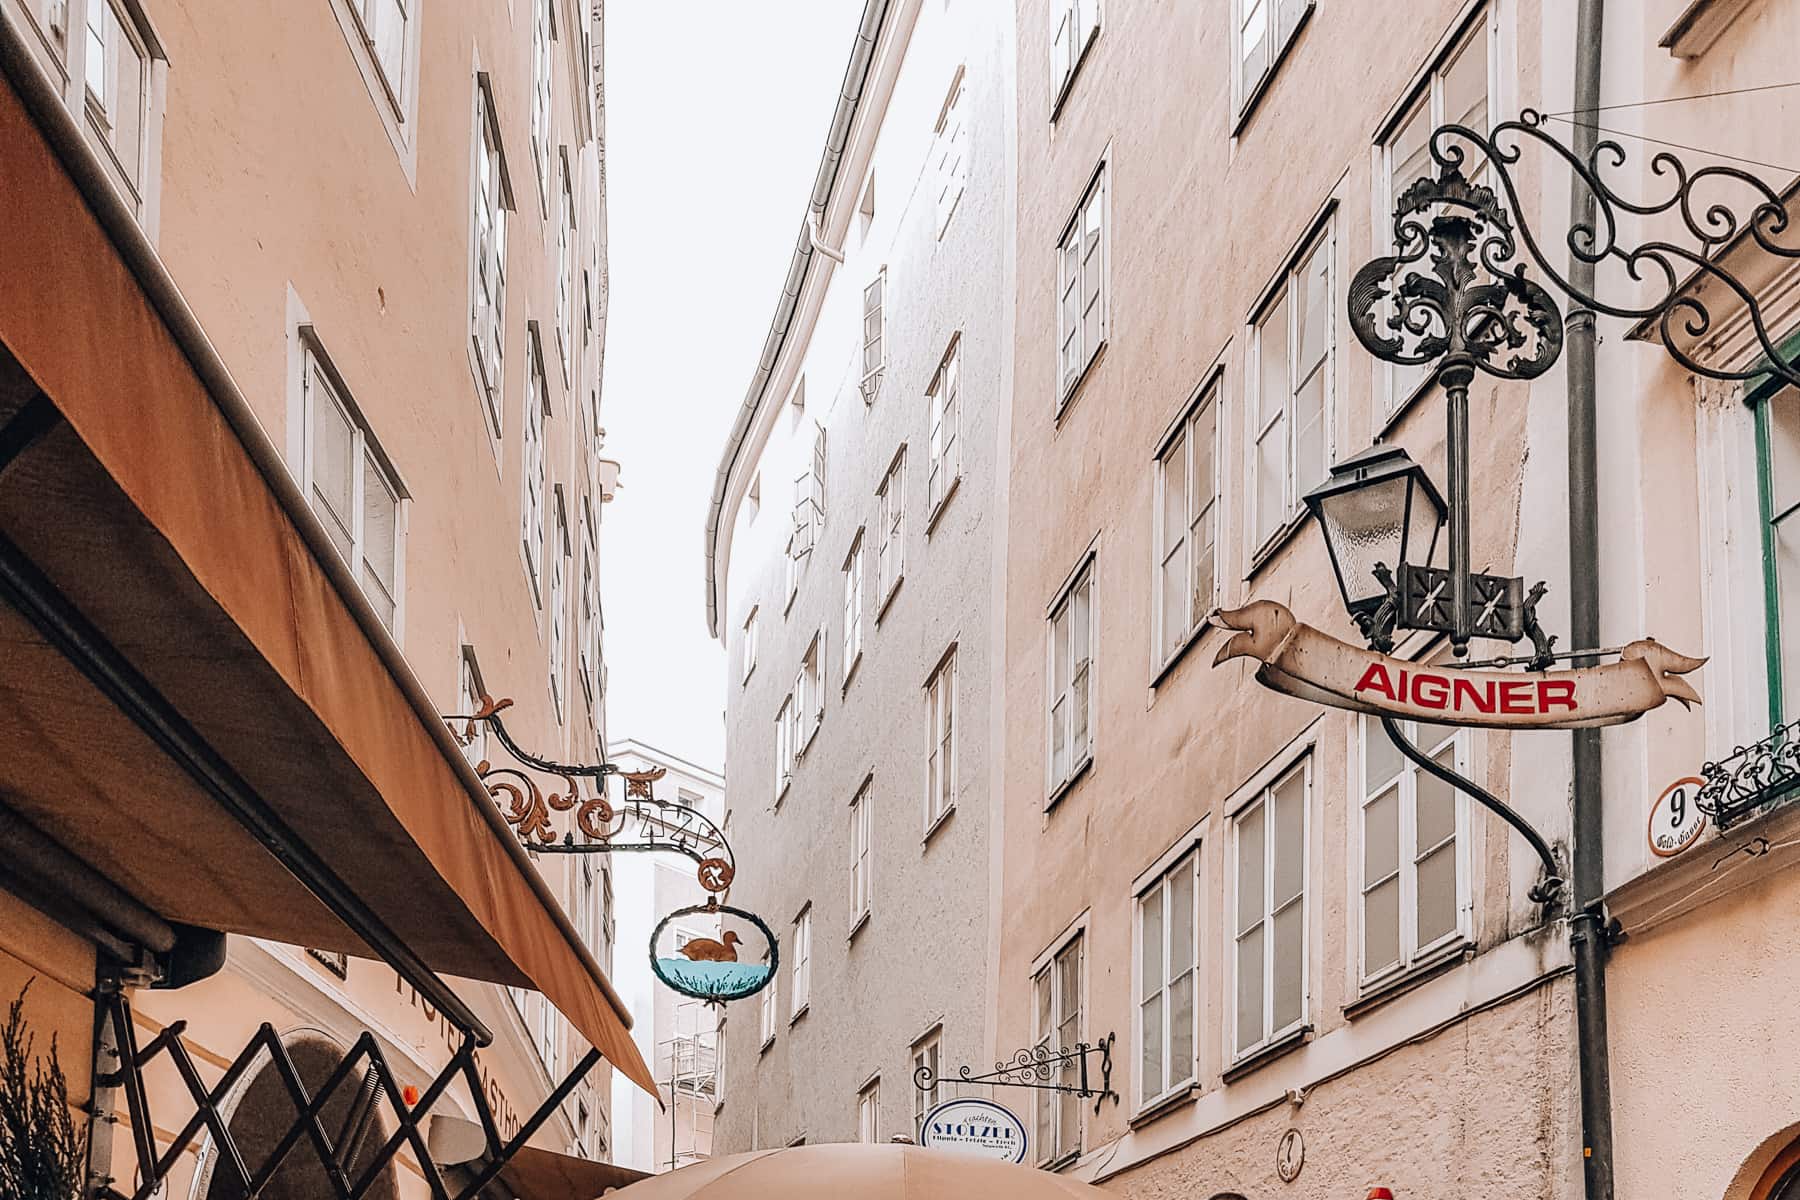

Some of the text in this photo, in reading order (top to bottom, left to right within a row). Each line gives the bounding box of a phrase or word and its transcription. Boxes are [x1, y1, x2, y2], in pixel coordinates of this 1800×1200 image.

[1354, 662, 1578, 714] AIGNER
[1670, 787, 1686, 829] 9
[933, 1122, 1016, 1139] STOLZER
